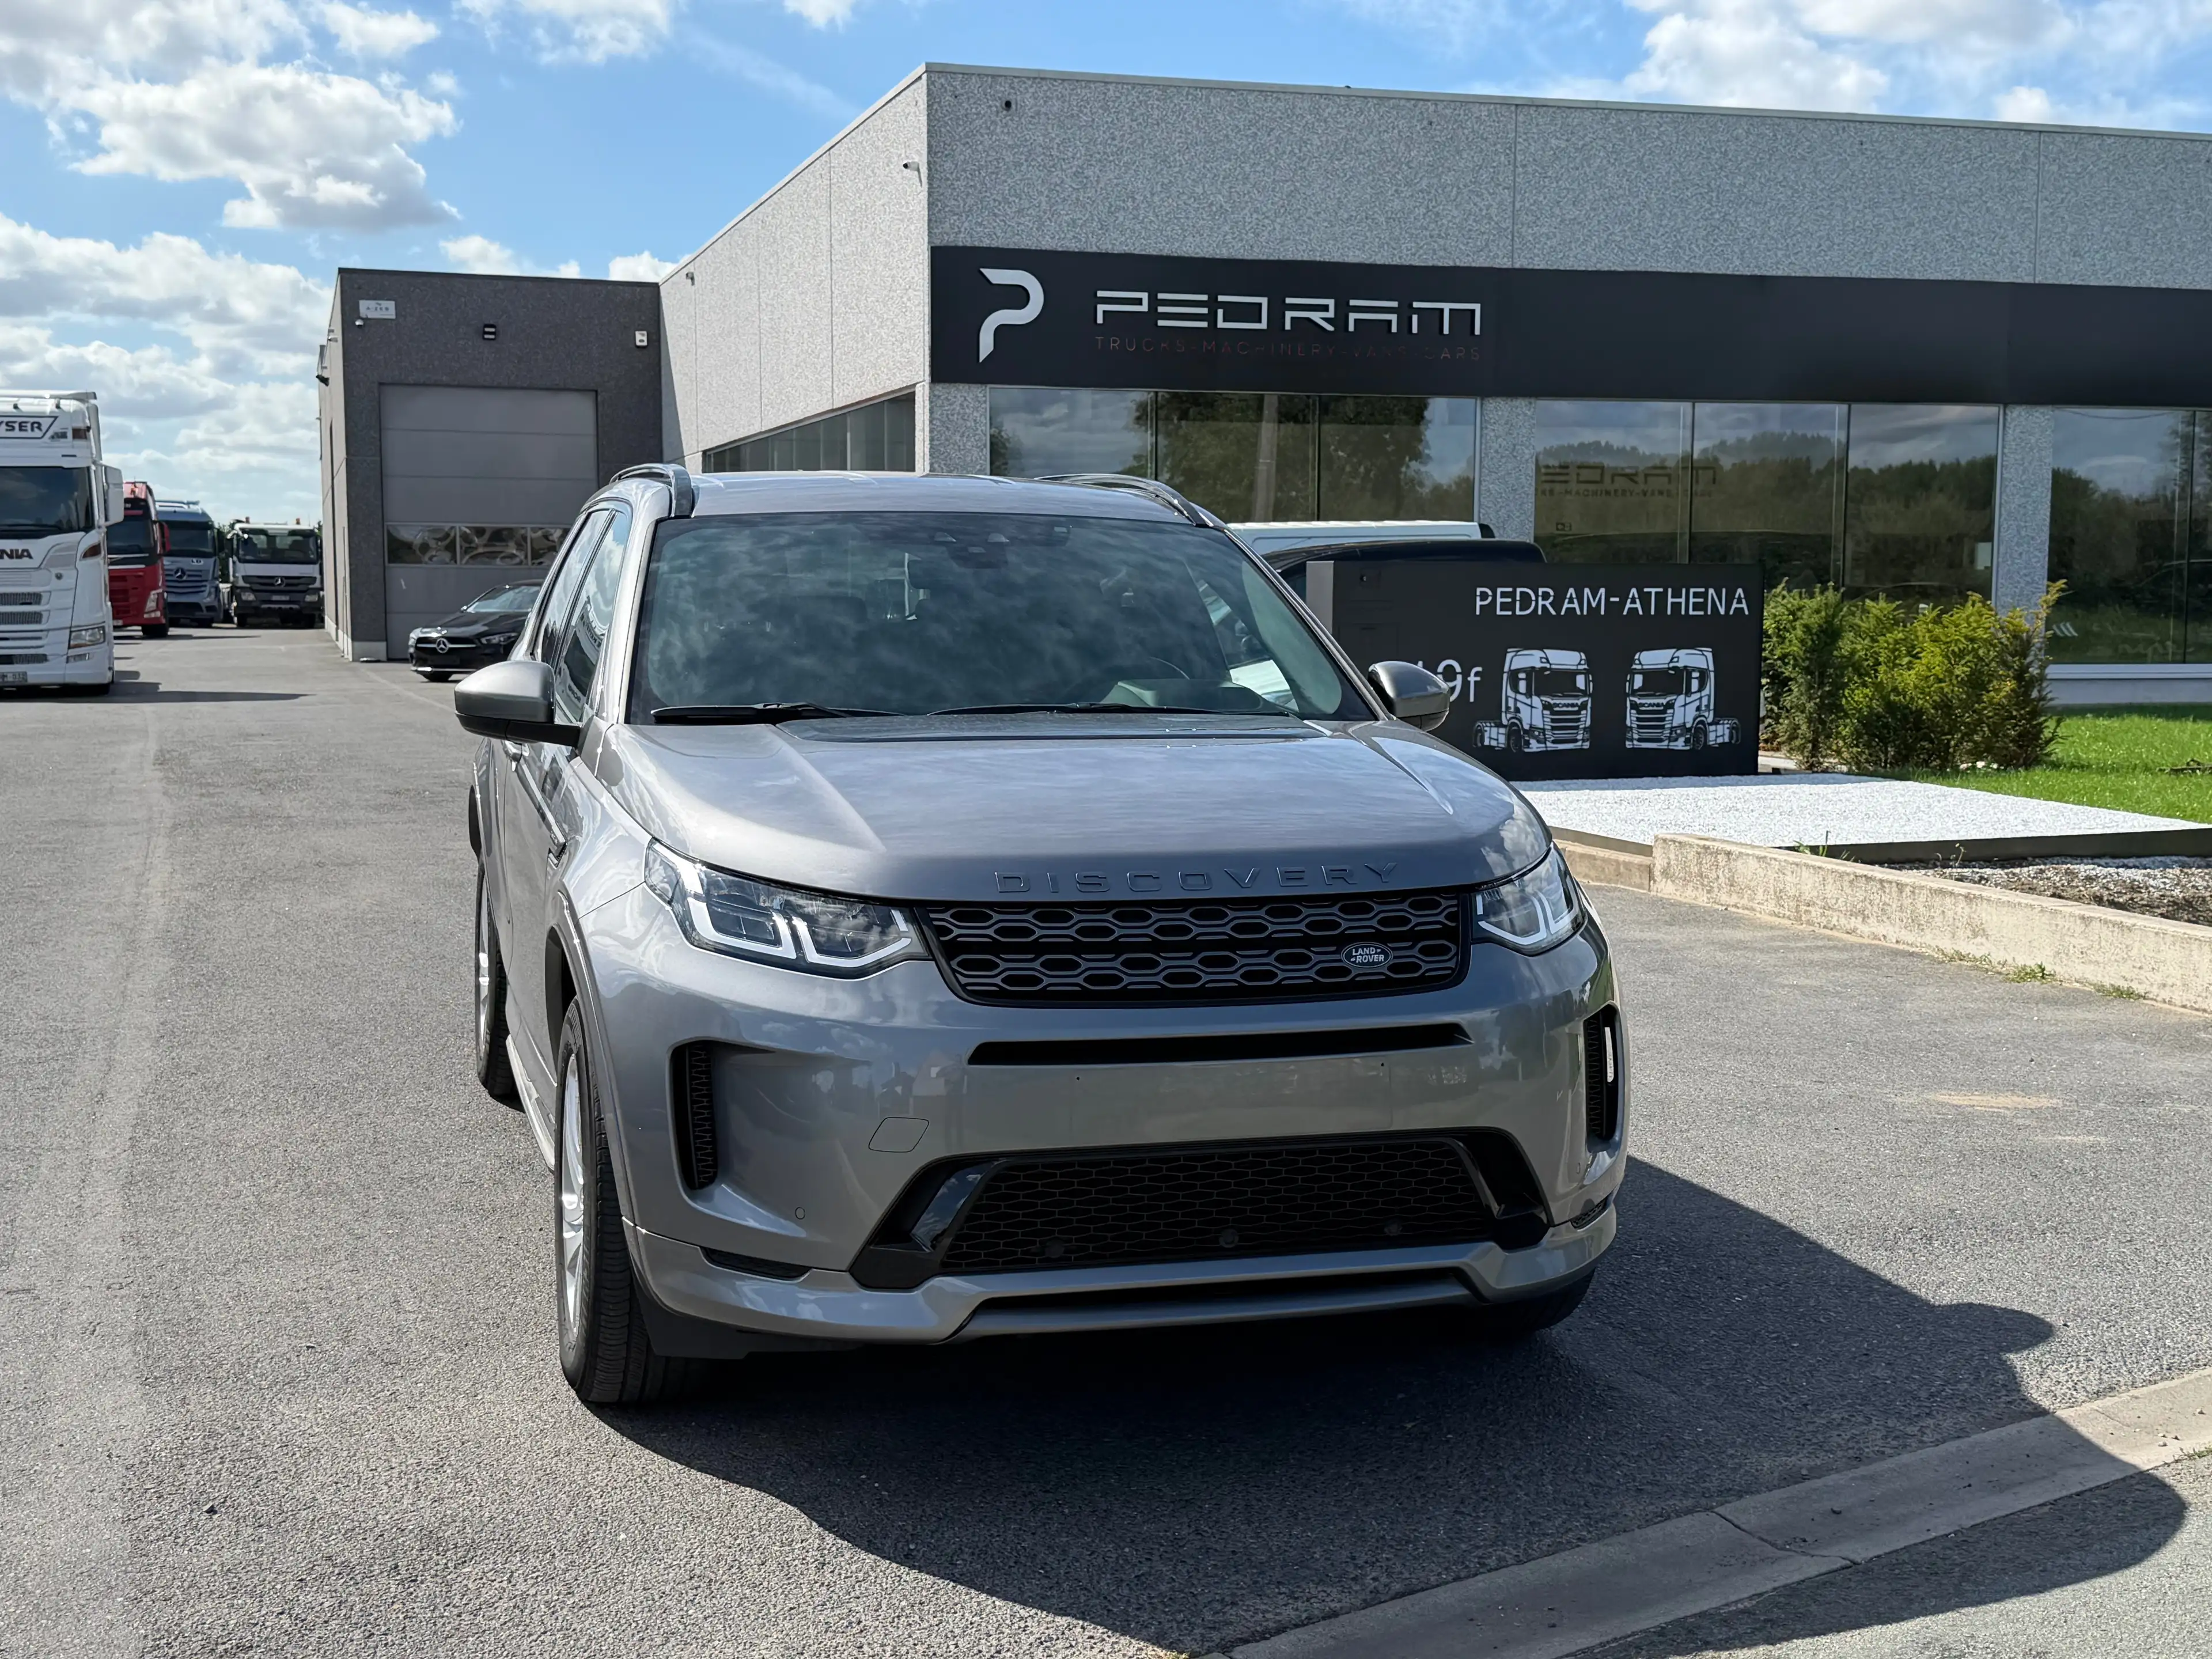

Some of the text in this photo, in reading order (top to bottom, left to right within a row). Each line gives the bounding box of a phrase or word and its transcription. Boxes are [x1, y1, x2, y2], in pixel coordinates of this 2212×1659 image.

[1097, 290, 1482, 335] PEDRAM
[1476, 587, 1749, 615] PEDRAM-ATHENA
[1418, 659, 1482, 702] 9f
[994, 862, 1398, 893] DISCOVERY
[1352, 946, 1376, 956] LAND
[1355, 954, 1385, 964] ROVER
